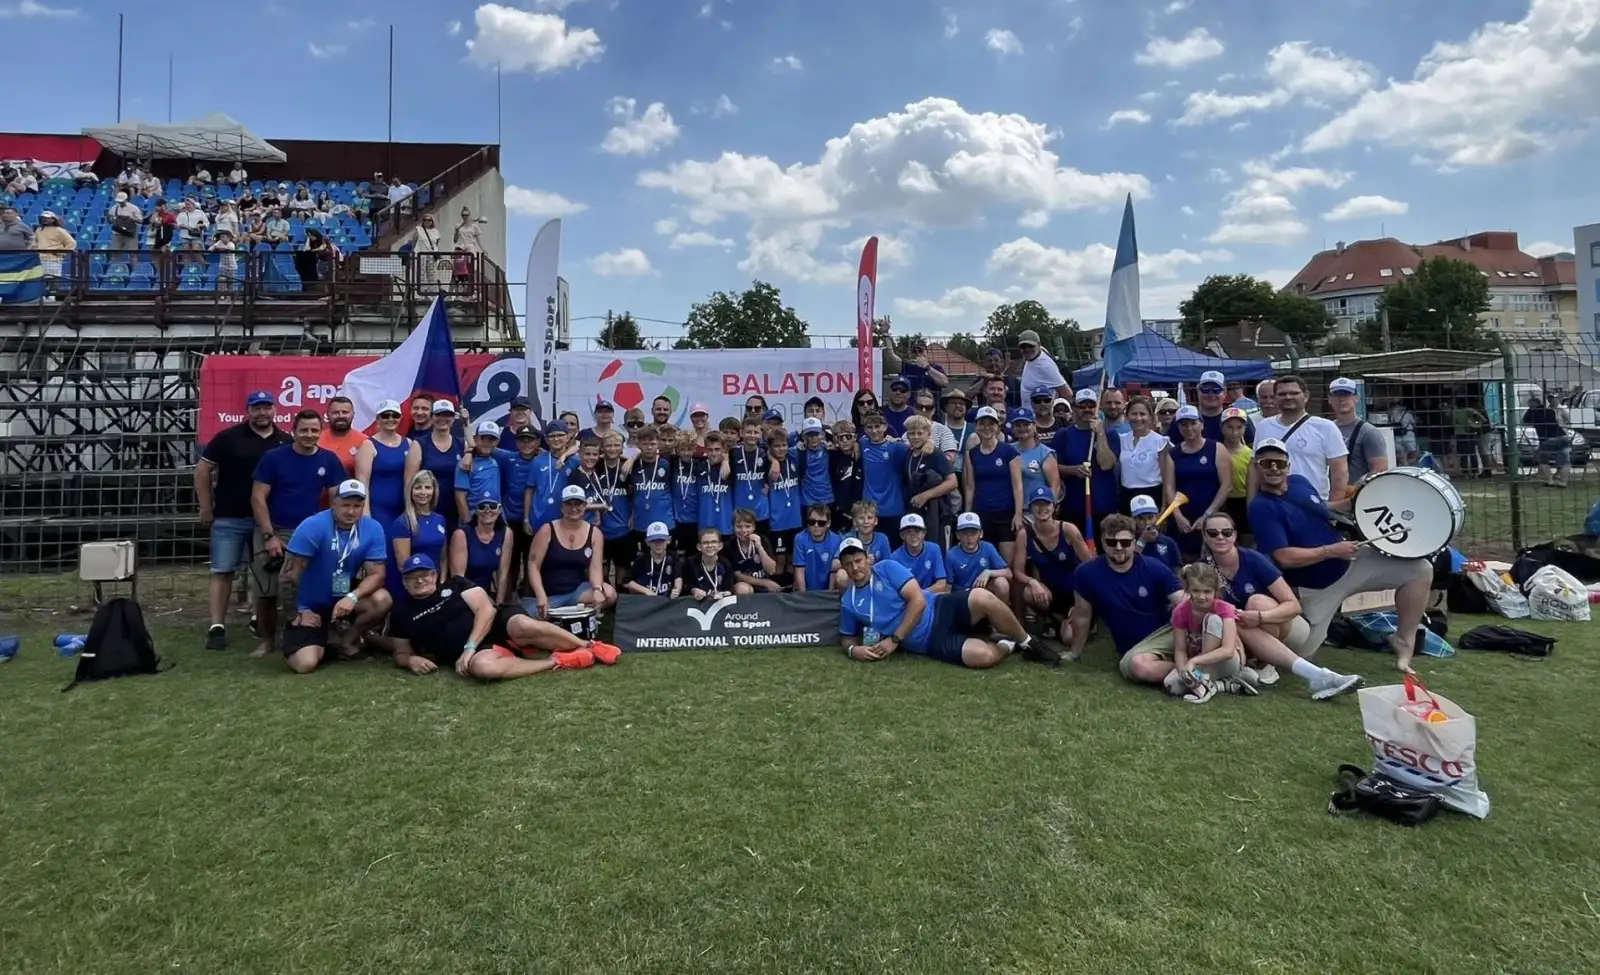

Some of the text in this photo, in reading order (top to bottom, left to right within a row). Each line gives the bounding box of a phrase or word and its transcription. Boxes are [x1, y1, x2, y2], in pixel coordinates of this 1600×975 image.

[543, 295, 556, 355] Sport
[723, 372, 853, 395] BALATON
[218, 413, 244, 423] Your
[734, 402, 844, 425] TOPY
[737, 471, 765, 481] TRADIX
[636, 481, 666, 491] TRADIX
[701, 483, 729, 493] TRADIX
[601, 487, 627, 497] RADI
[724, 611, 759, 620] Around
[724, 620, 771, 630] the Sport
[636, 633, 820, 648] INTERNATIONAL TOURNAMENTS
[1366, 734, 1464, 778] TESCO
